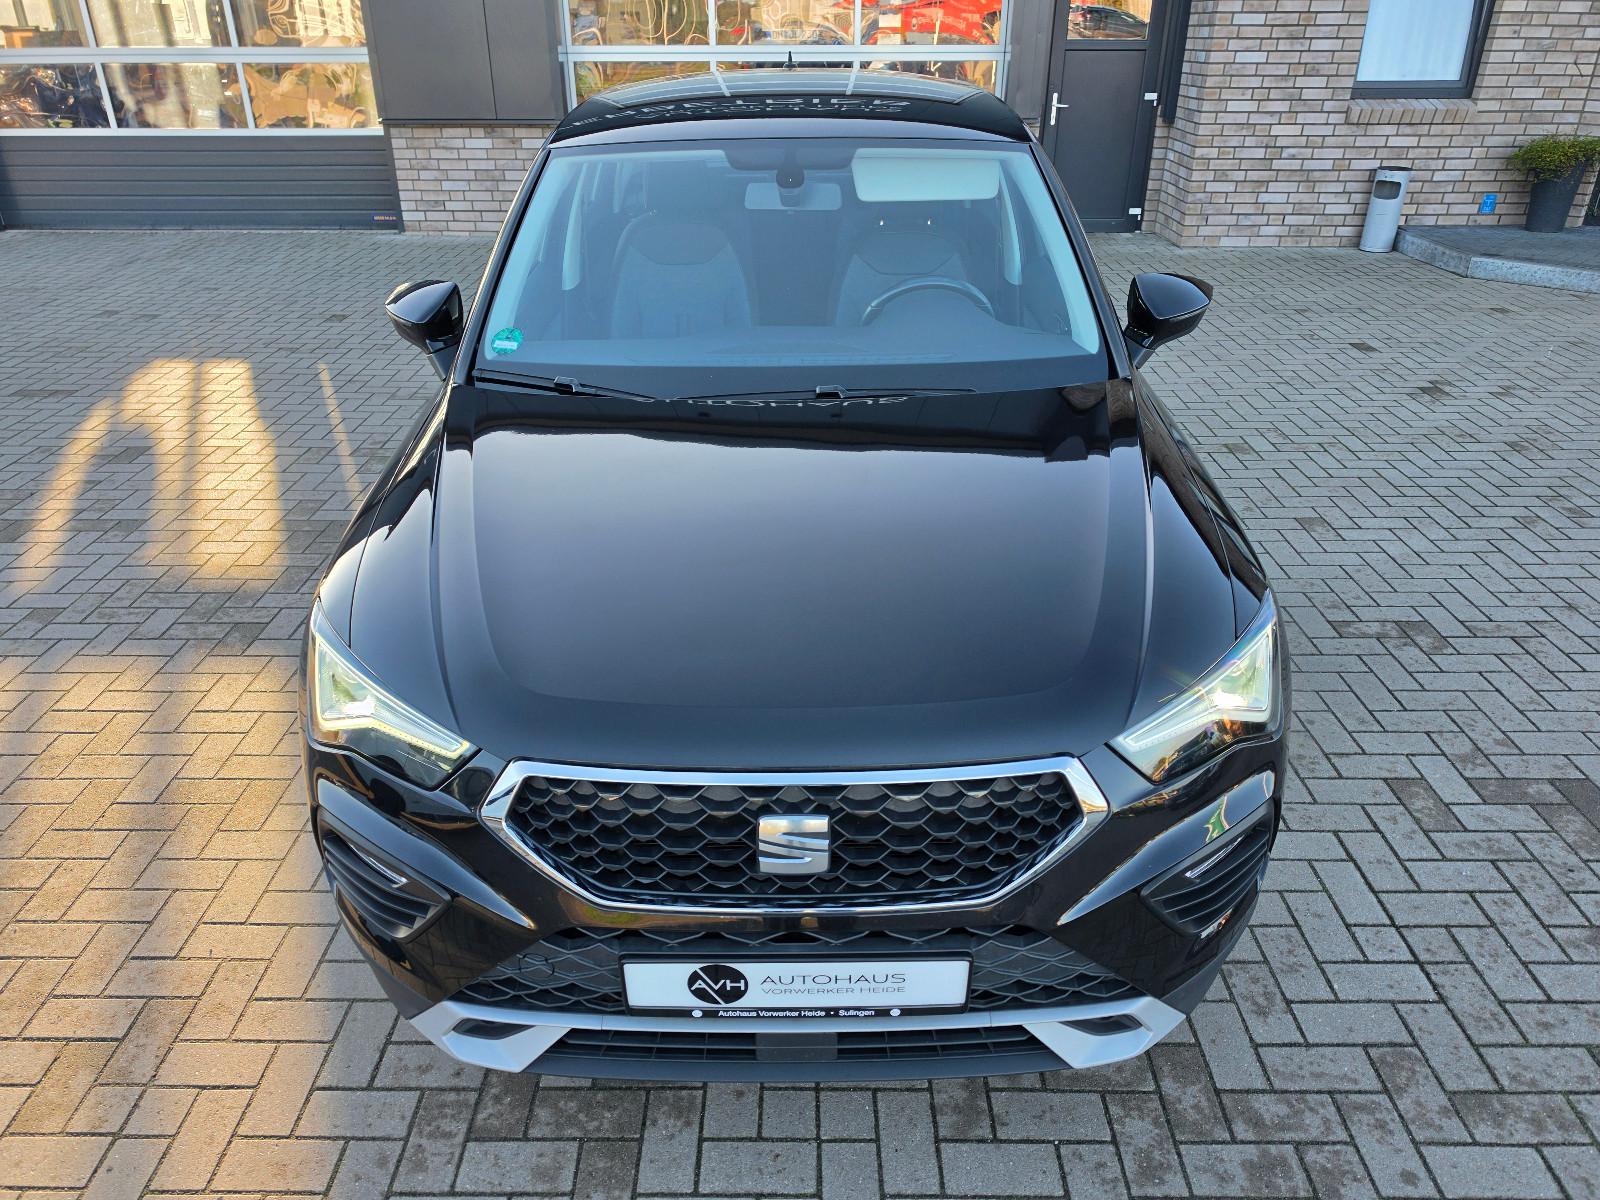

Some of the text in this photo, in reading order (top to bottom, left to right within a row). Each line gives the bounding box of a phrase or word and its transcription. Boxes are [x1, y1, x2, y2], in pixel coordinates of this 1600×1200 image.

[689, 967, 746, 1004] AVH
[760, 974, 906, 986] AUTOHAUS
[761, 987, 855, 995] VORWERKER
